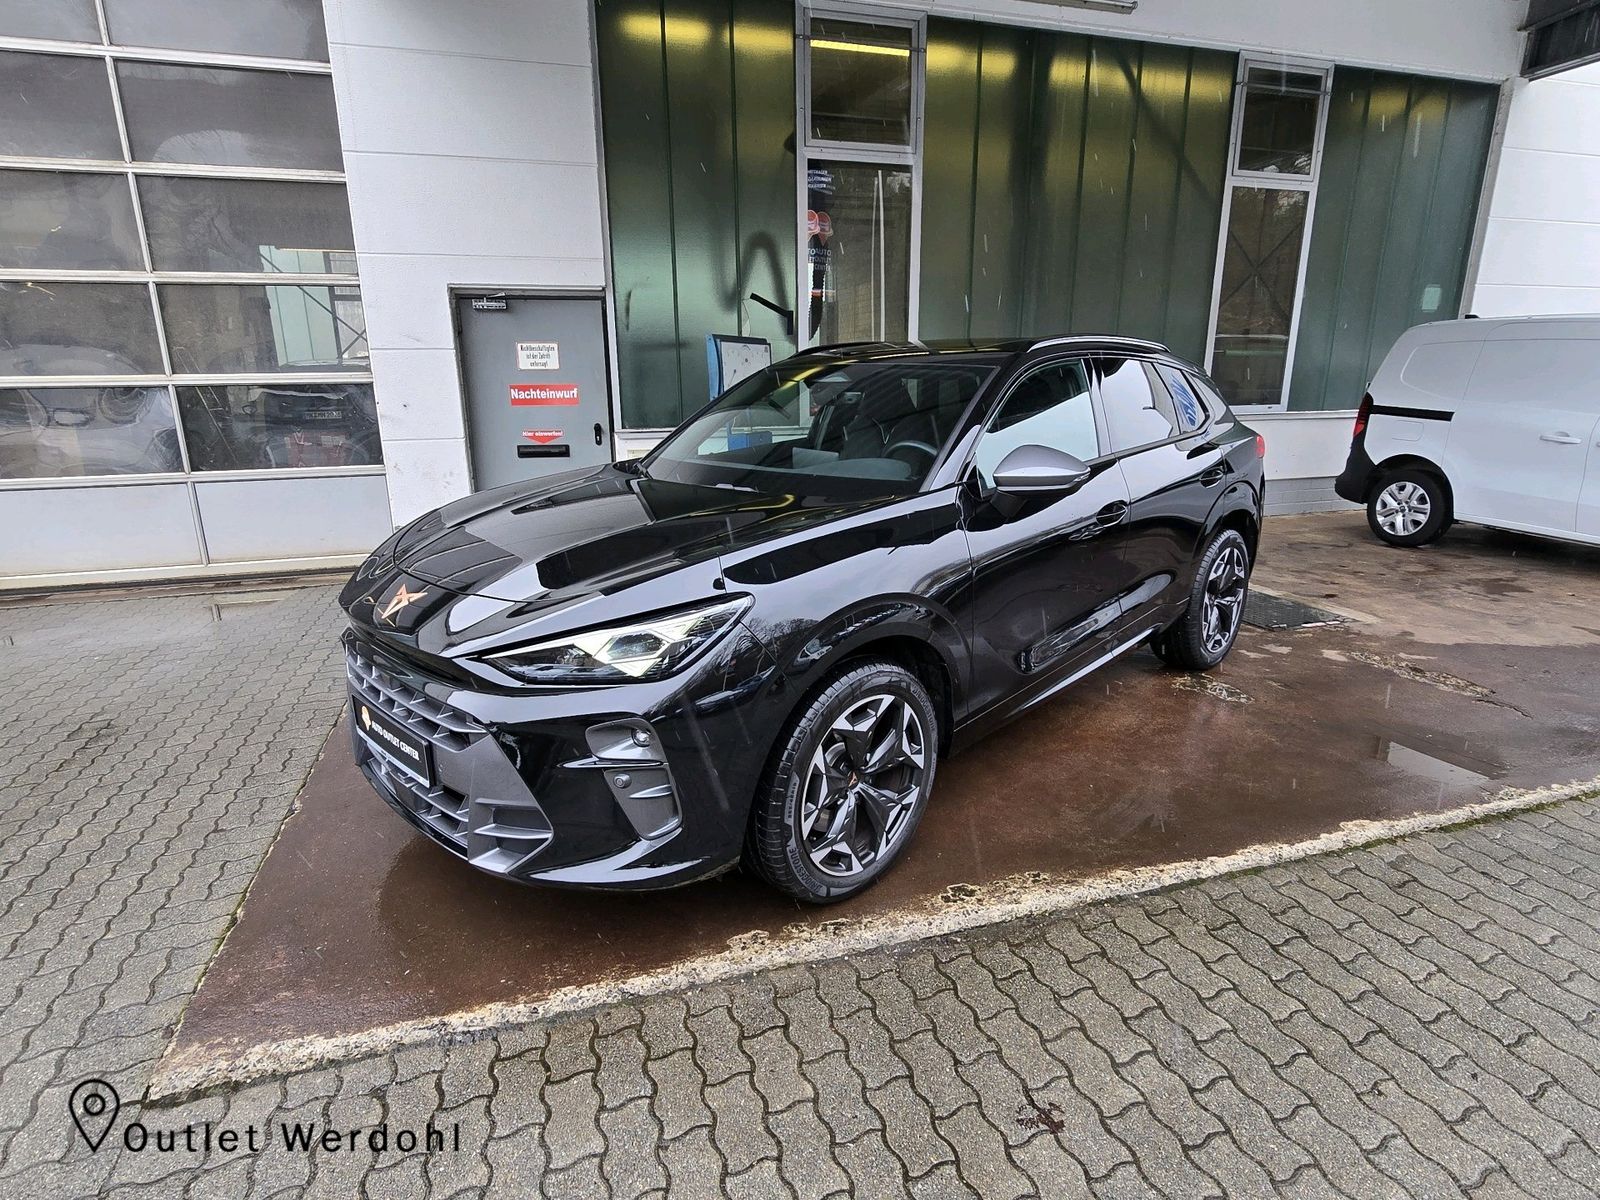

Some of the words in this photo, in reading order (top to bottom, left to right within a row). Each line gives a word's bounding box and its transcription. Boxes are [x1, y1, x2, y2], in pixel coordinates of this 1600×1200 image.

[510, 388, 578, 399] Nachteinwurf
[371, 720, 383, 736] AUTO
[383, 729, 400, 748] OUTLET
[400, 741, 420, 761] CENTER
